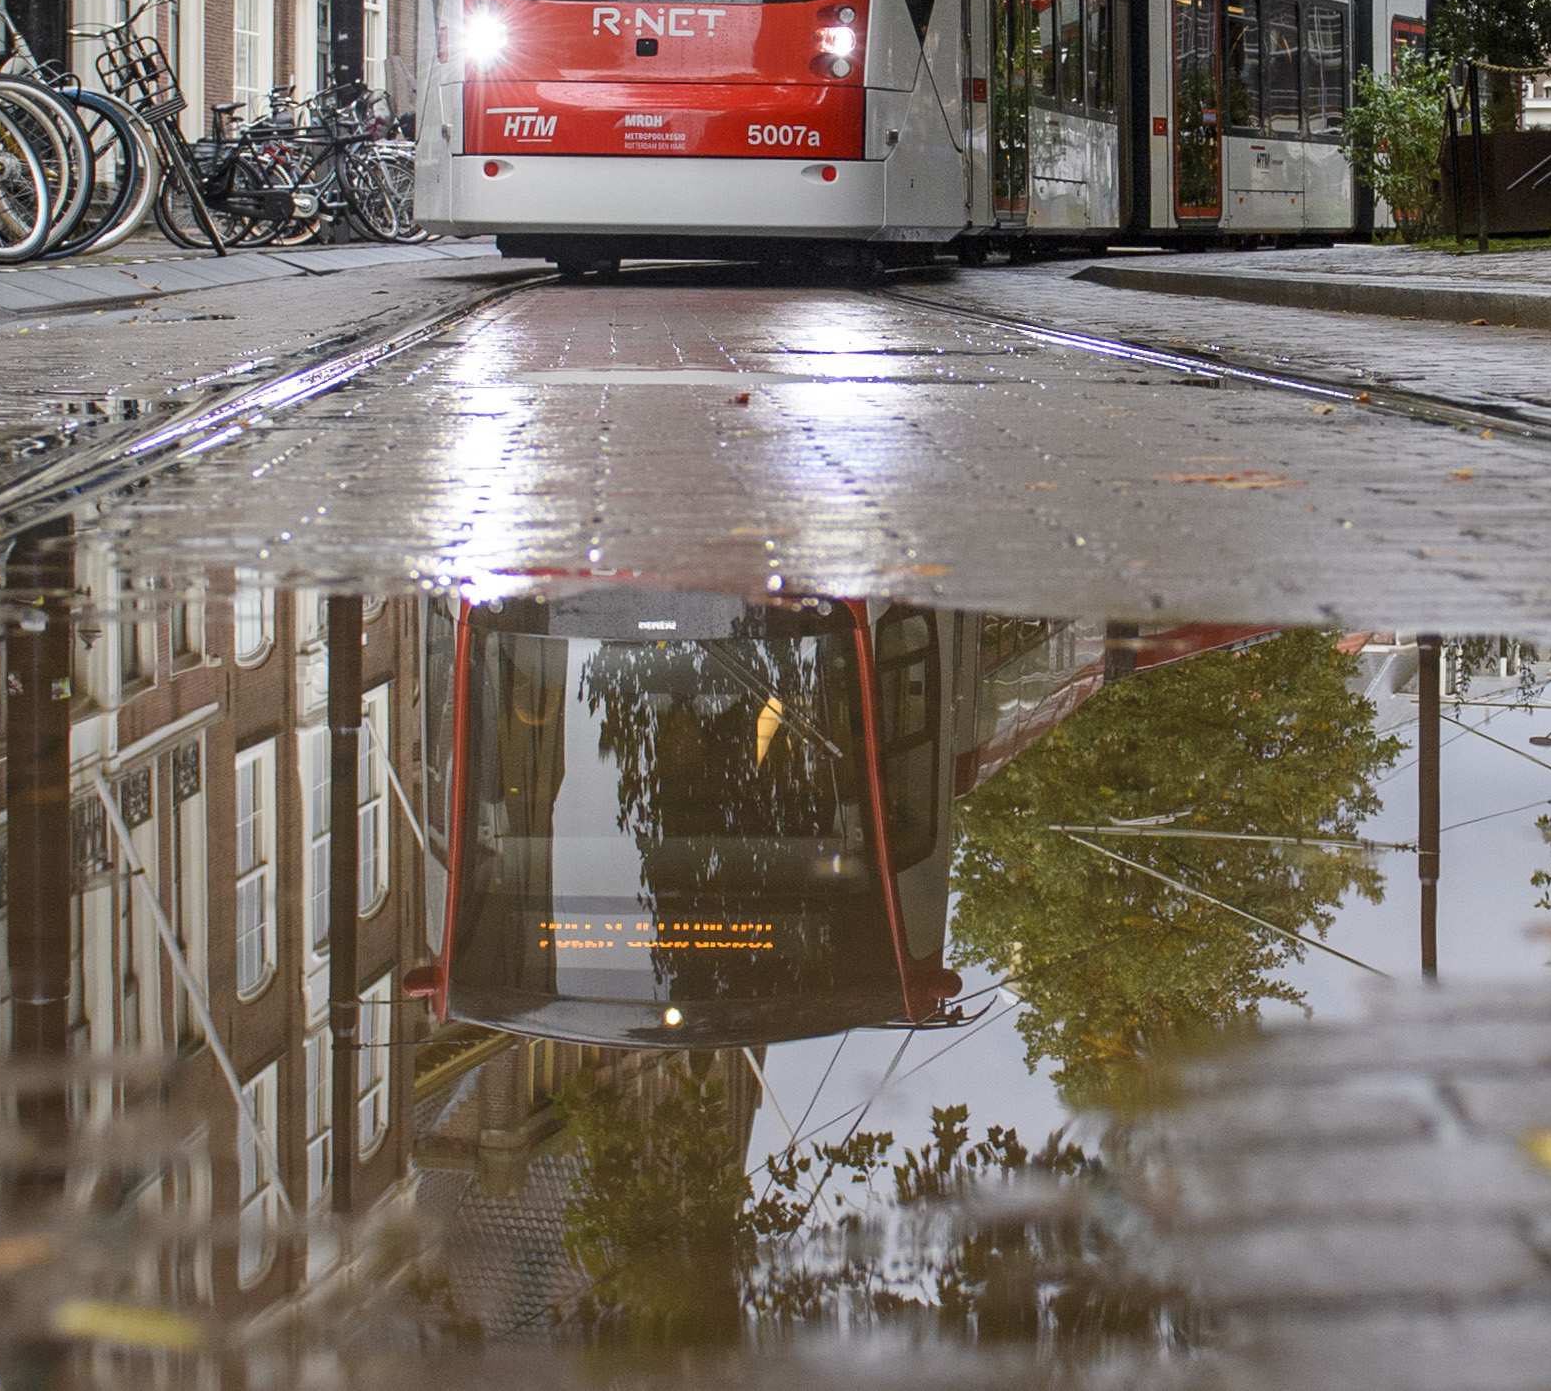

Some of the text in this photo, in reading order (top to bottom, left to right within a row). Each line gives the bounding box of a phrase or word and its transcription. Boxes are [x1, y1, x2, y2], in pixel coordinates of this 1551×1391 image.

[503, 115, 558, 137] HTM
[624, 114, 663, 127] MRDH
[747, 124, 821, 147] 5007a
